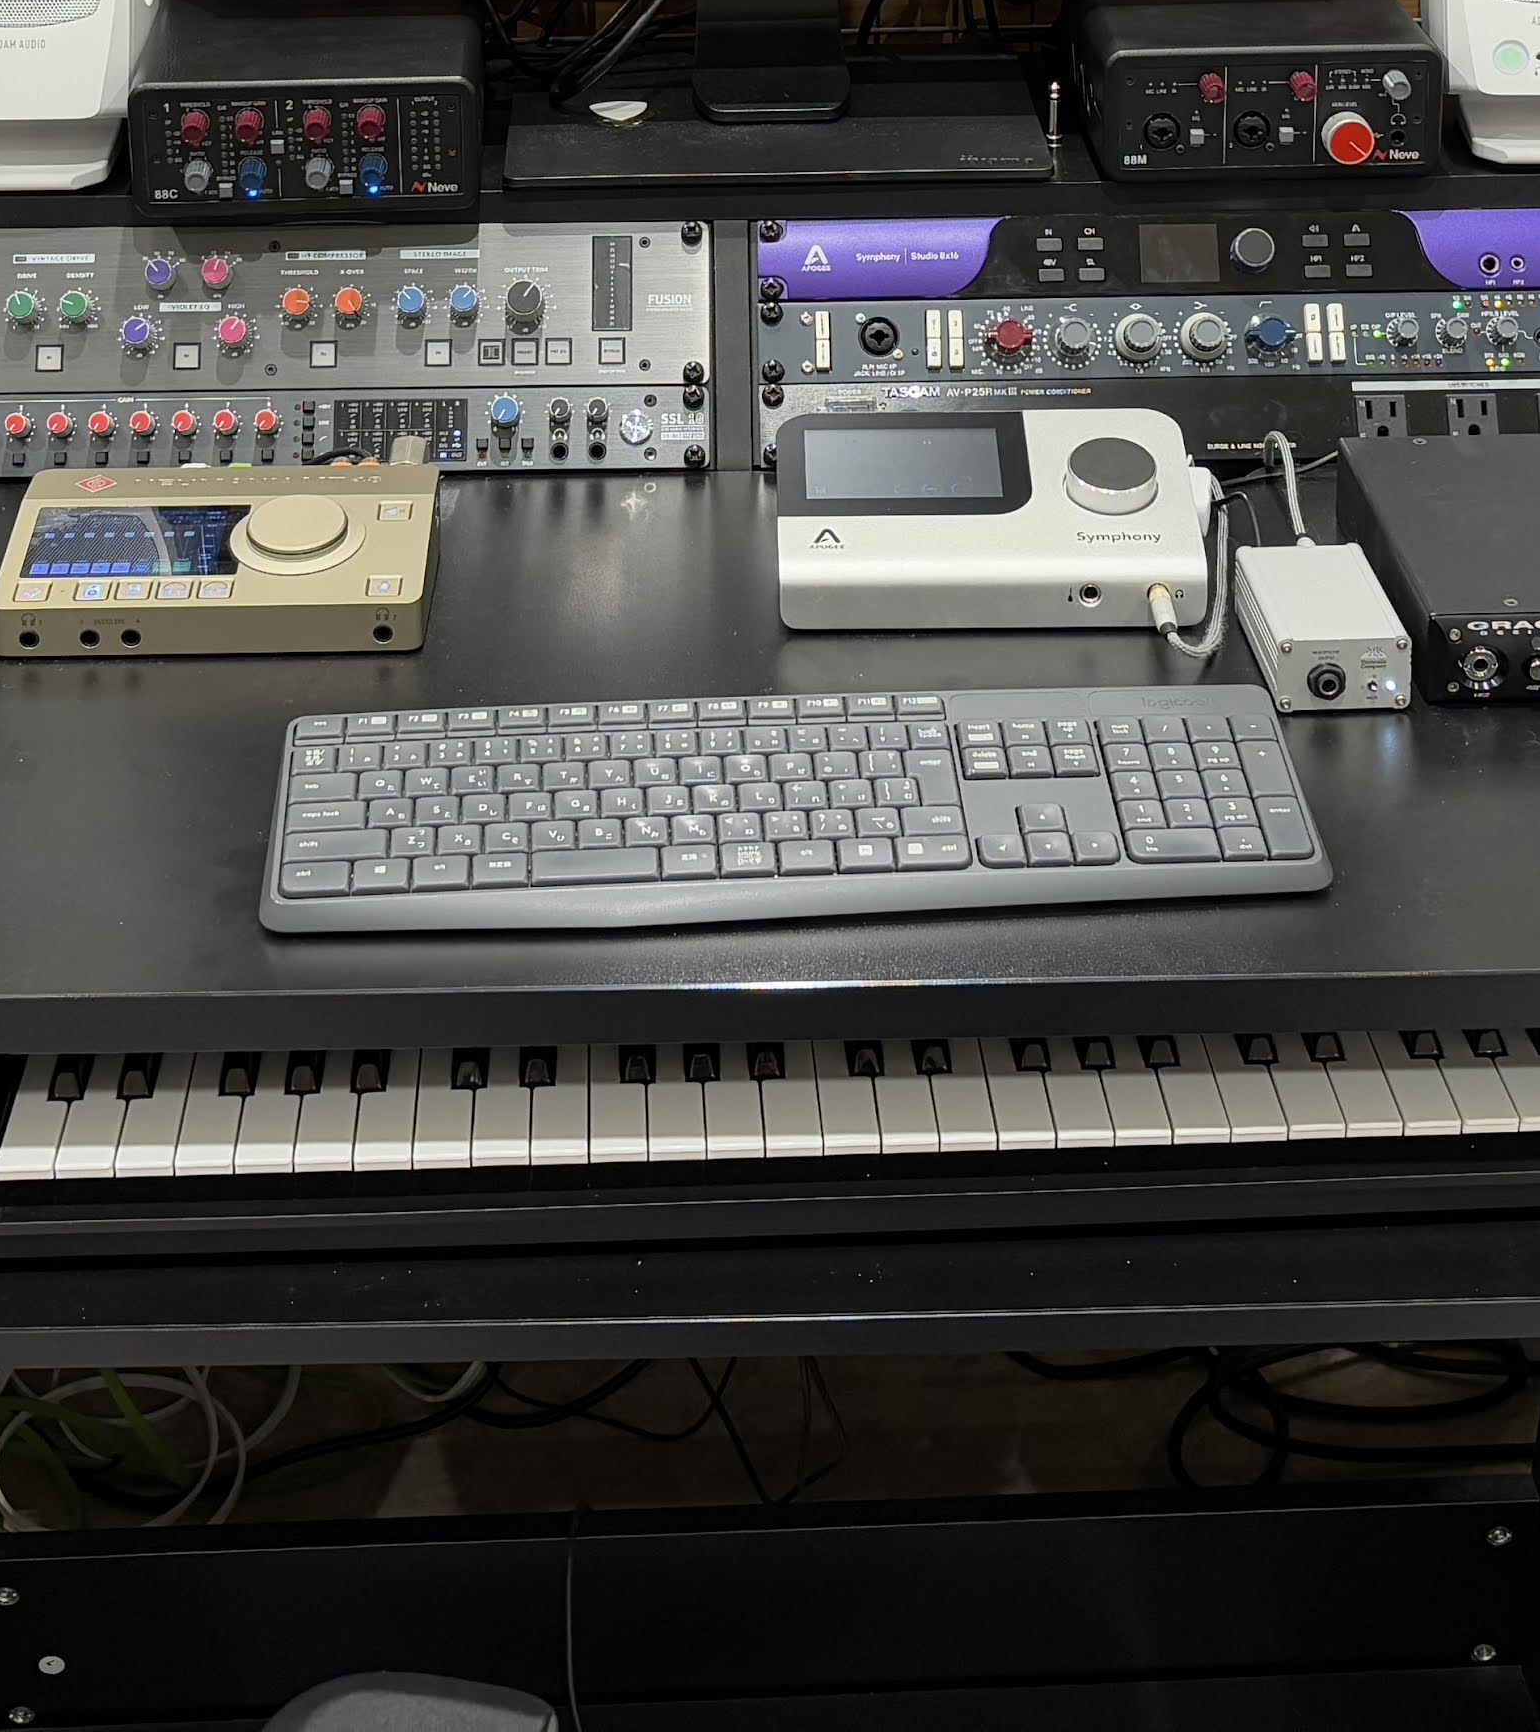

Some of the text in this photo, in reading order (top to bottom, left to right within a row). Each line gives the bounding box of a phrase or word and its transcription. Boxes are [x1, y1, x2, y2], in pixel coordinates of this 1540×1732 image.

[19, 39, 46, 49] AUDIO
[1123, 154, 1147, 166] 88M
[1389, 149, 1419, 161] Neve
[428, 181, 458, 192] Neve
[154, 189, 178, 199] 88C
[856, 252, 900, 264] Symphony
[911, 251, 938, 262] Studio
[649, 294, 691, 305] FUSION
[882, 386, 940, 399] TASCAM
[947, 387, 993, 397] AV-P25R
[661, 414, 685, 424] SSL
[1077, 531, 1161, 545] Symphony
